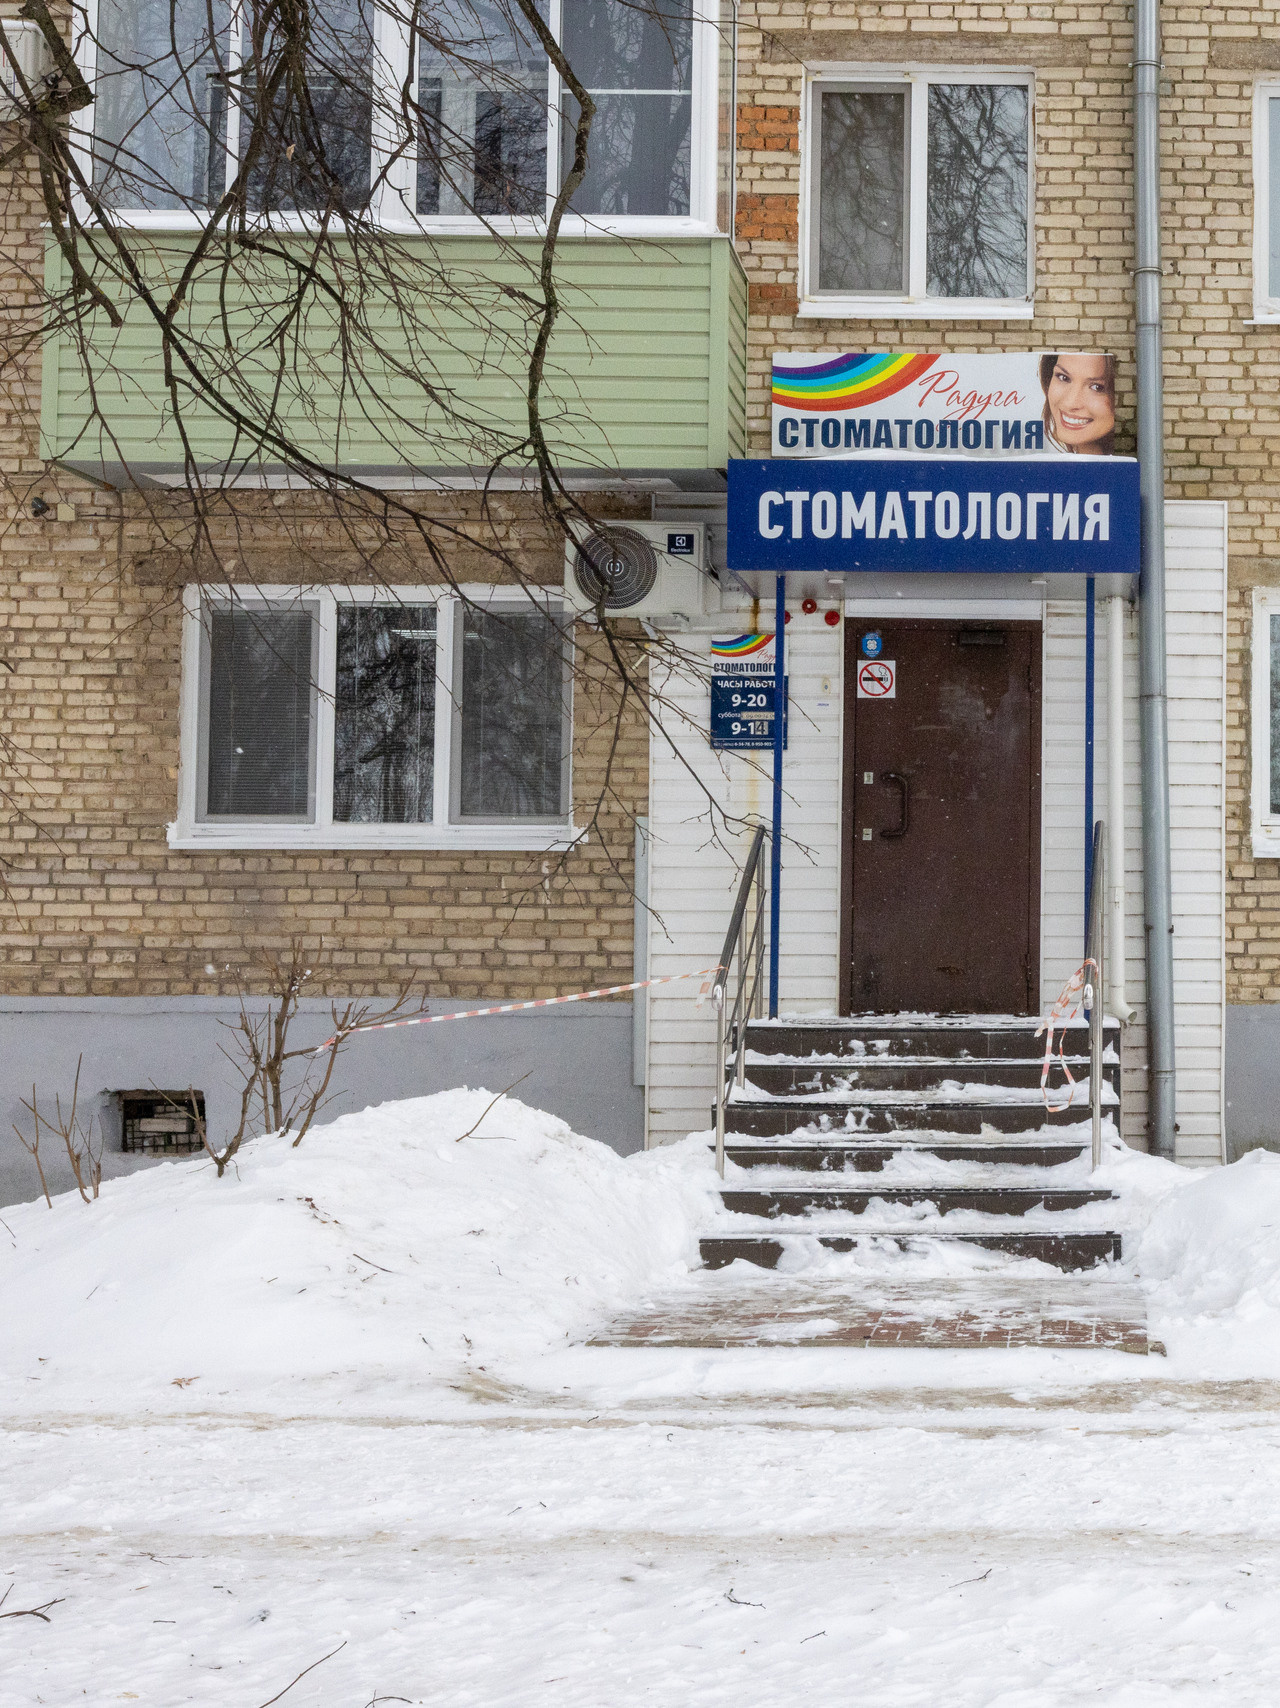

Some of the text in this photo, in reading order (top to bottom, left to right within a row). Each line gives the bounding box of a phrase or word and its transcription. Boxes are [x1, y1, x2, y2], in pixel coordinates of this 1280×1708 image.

[918, 370, 1026, 430] Радуга
[778, 417, 1044, 450] СТОМАТОЛОГИЯ
[758, 491, 1110, 541] СТОМАТОЛОГИЯ
[713, 662, 776, 672] СТОМАТОЛОГ
[717, 680, 743, 688] ЧАСЫ
[731, 694, 767, 707] 9-20
